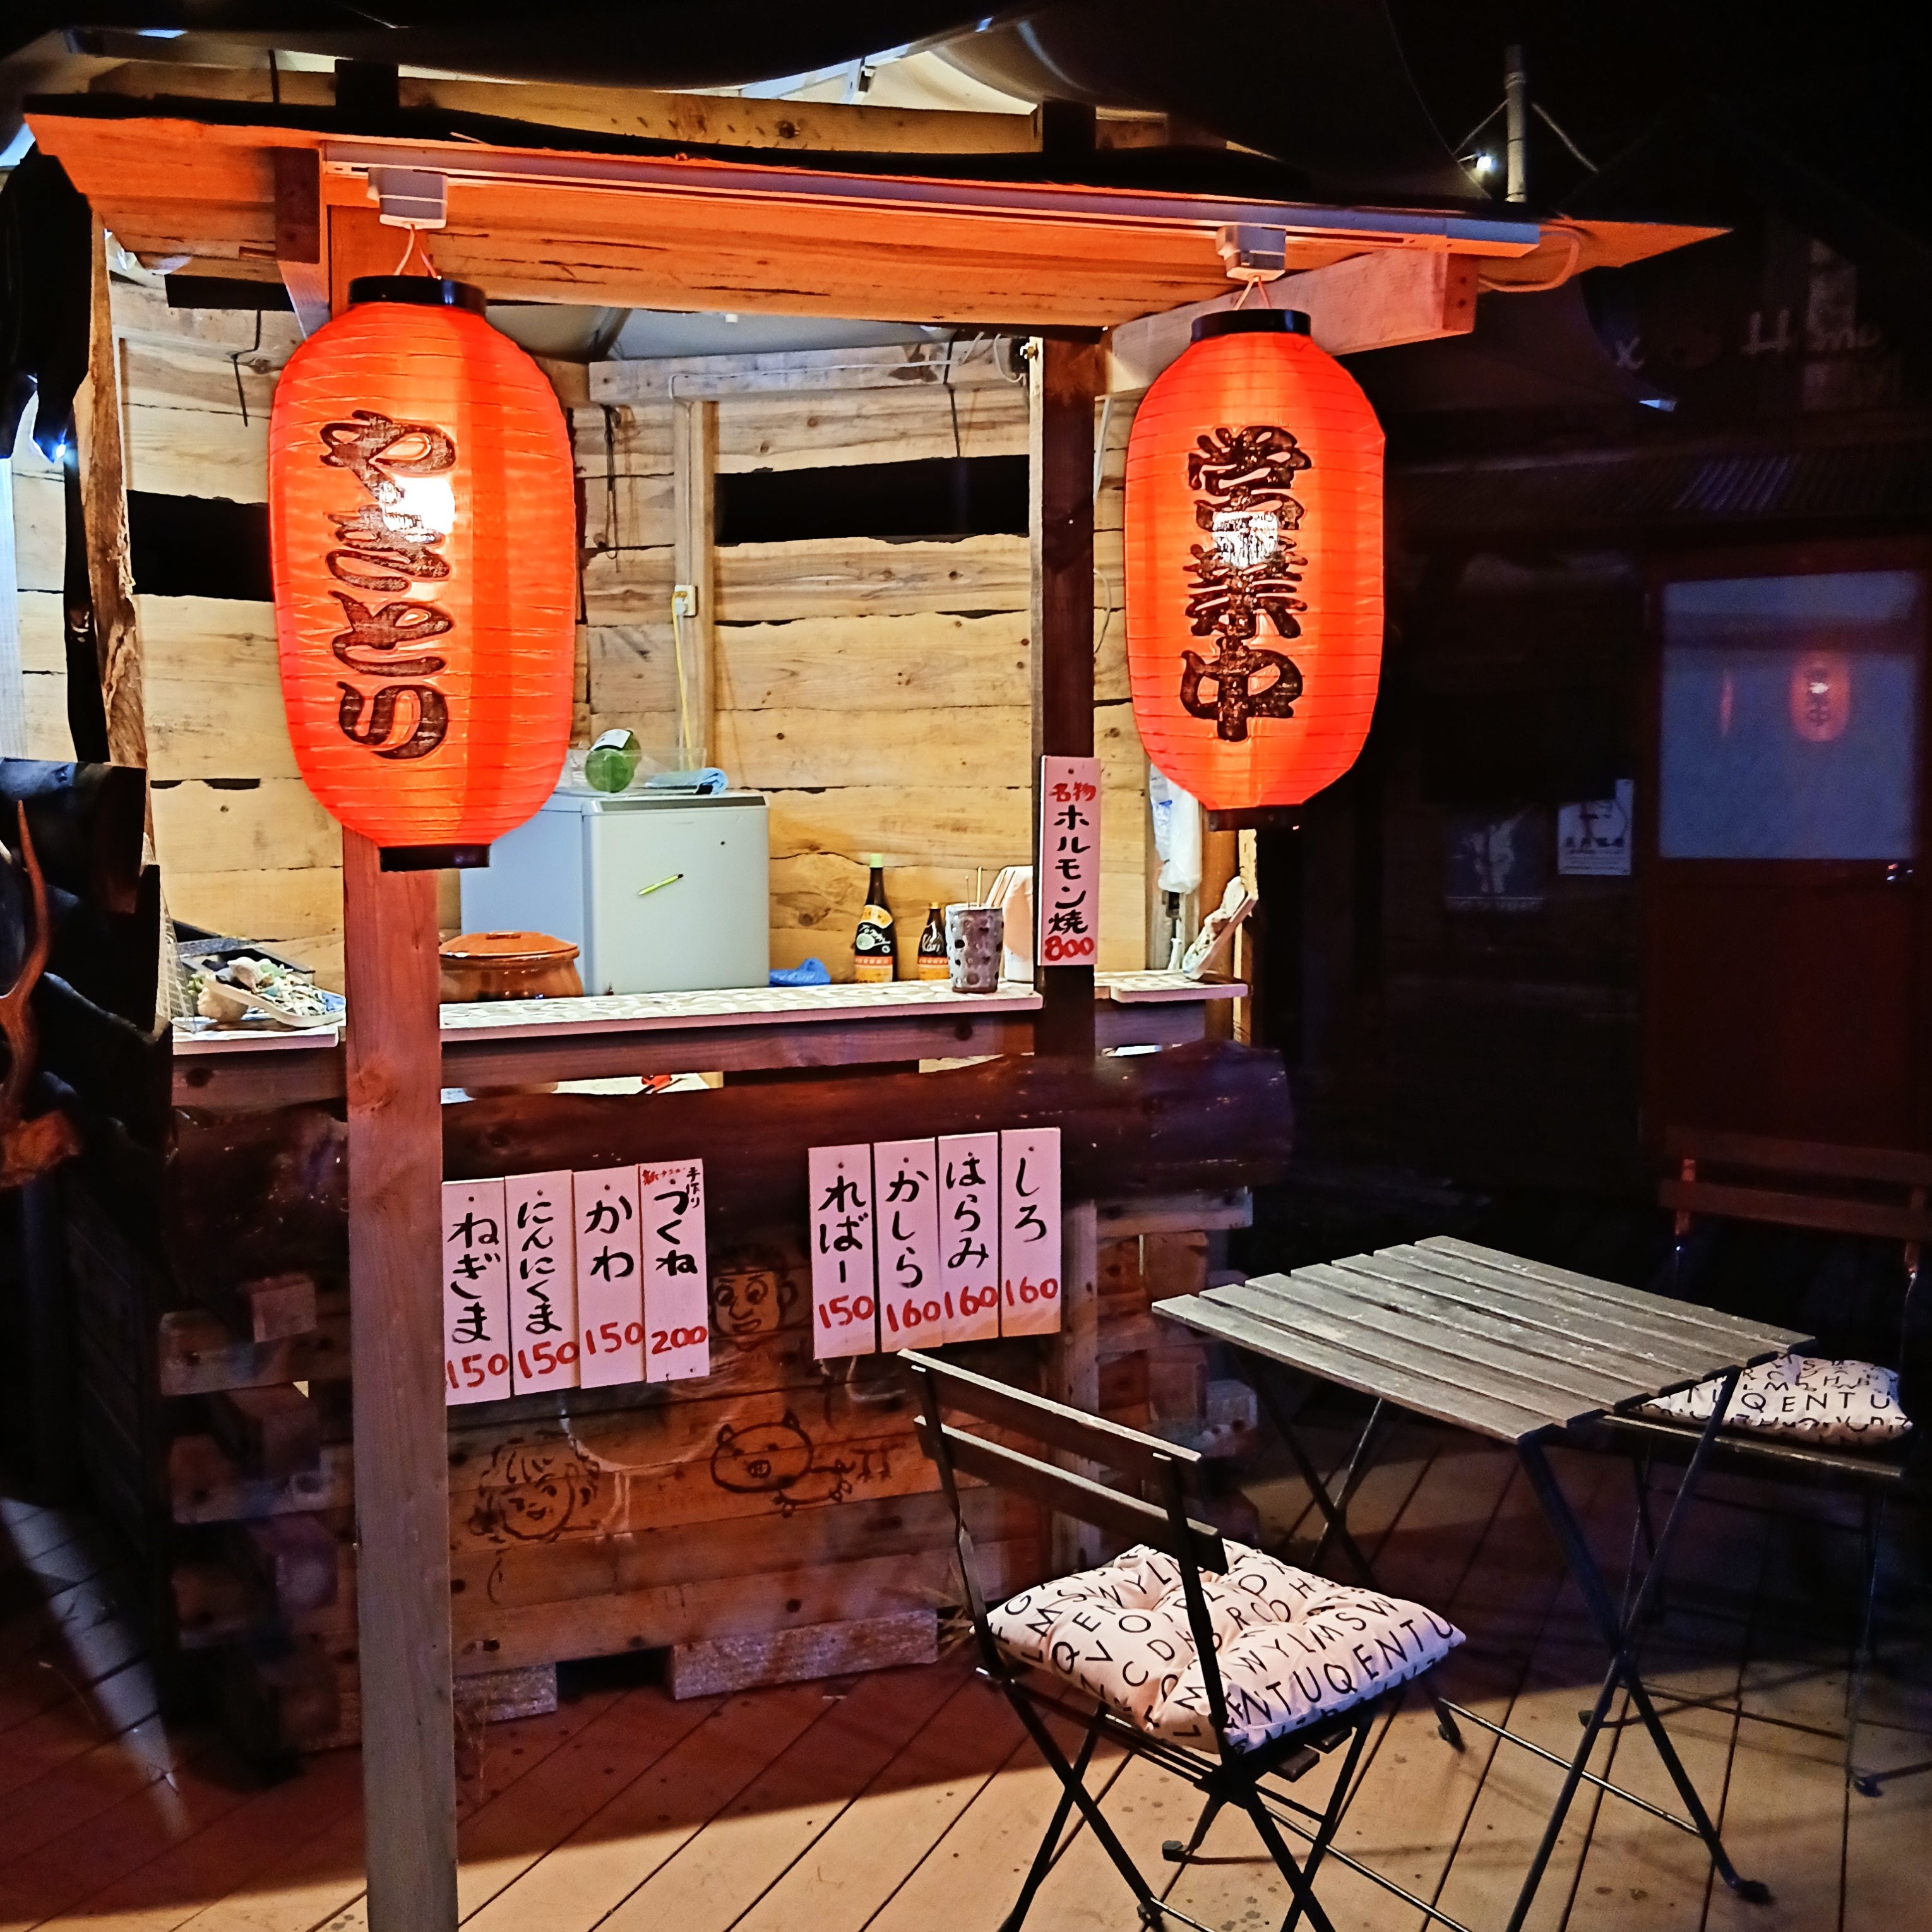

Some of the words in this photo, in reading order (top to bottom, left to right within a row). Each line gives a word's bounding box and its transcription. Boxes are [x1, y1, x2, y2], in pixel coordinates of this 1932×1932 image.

[320, 409, 456, 760] やきとり
[1049, 782, 1097, 802] 名物
[1048, 804, 1090, 935] ホルモン焼
[1044, 935, 1095, 962] 800
[946, 1157, 989, 1269] はらみ
[1015, 1157, 1047, 1243] しろ
[584, 1195, 635, 1282] かわ
[653, 1190, 698, 1277] つくね
[818, 1175, 869, 1284] ればー
[885, 1170, 929, 1289] かしら
[447, 1212, 501, 1344] ねぎま
[517, 1202, 563, 1335] にんにくま
[945, 1286, 998, 1320] 160
[1006, 1277, 1058, 1307] 160
[819, 1295, 874, 1329] 150
[886, 1299, 941, 1332] 160
[586, 1322, 643, 1354] 150
[652, 1326, 708, 1354] 200
[448, 1354, 508, 1388] 150
[518, 1341, 579, 1379] 150
[1741, 1392, 1890, 1413] QENTU
